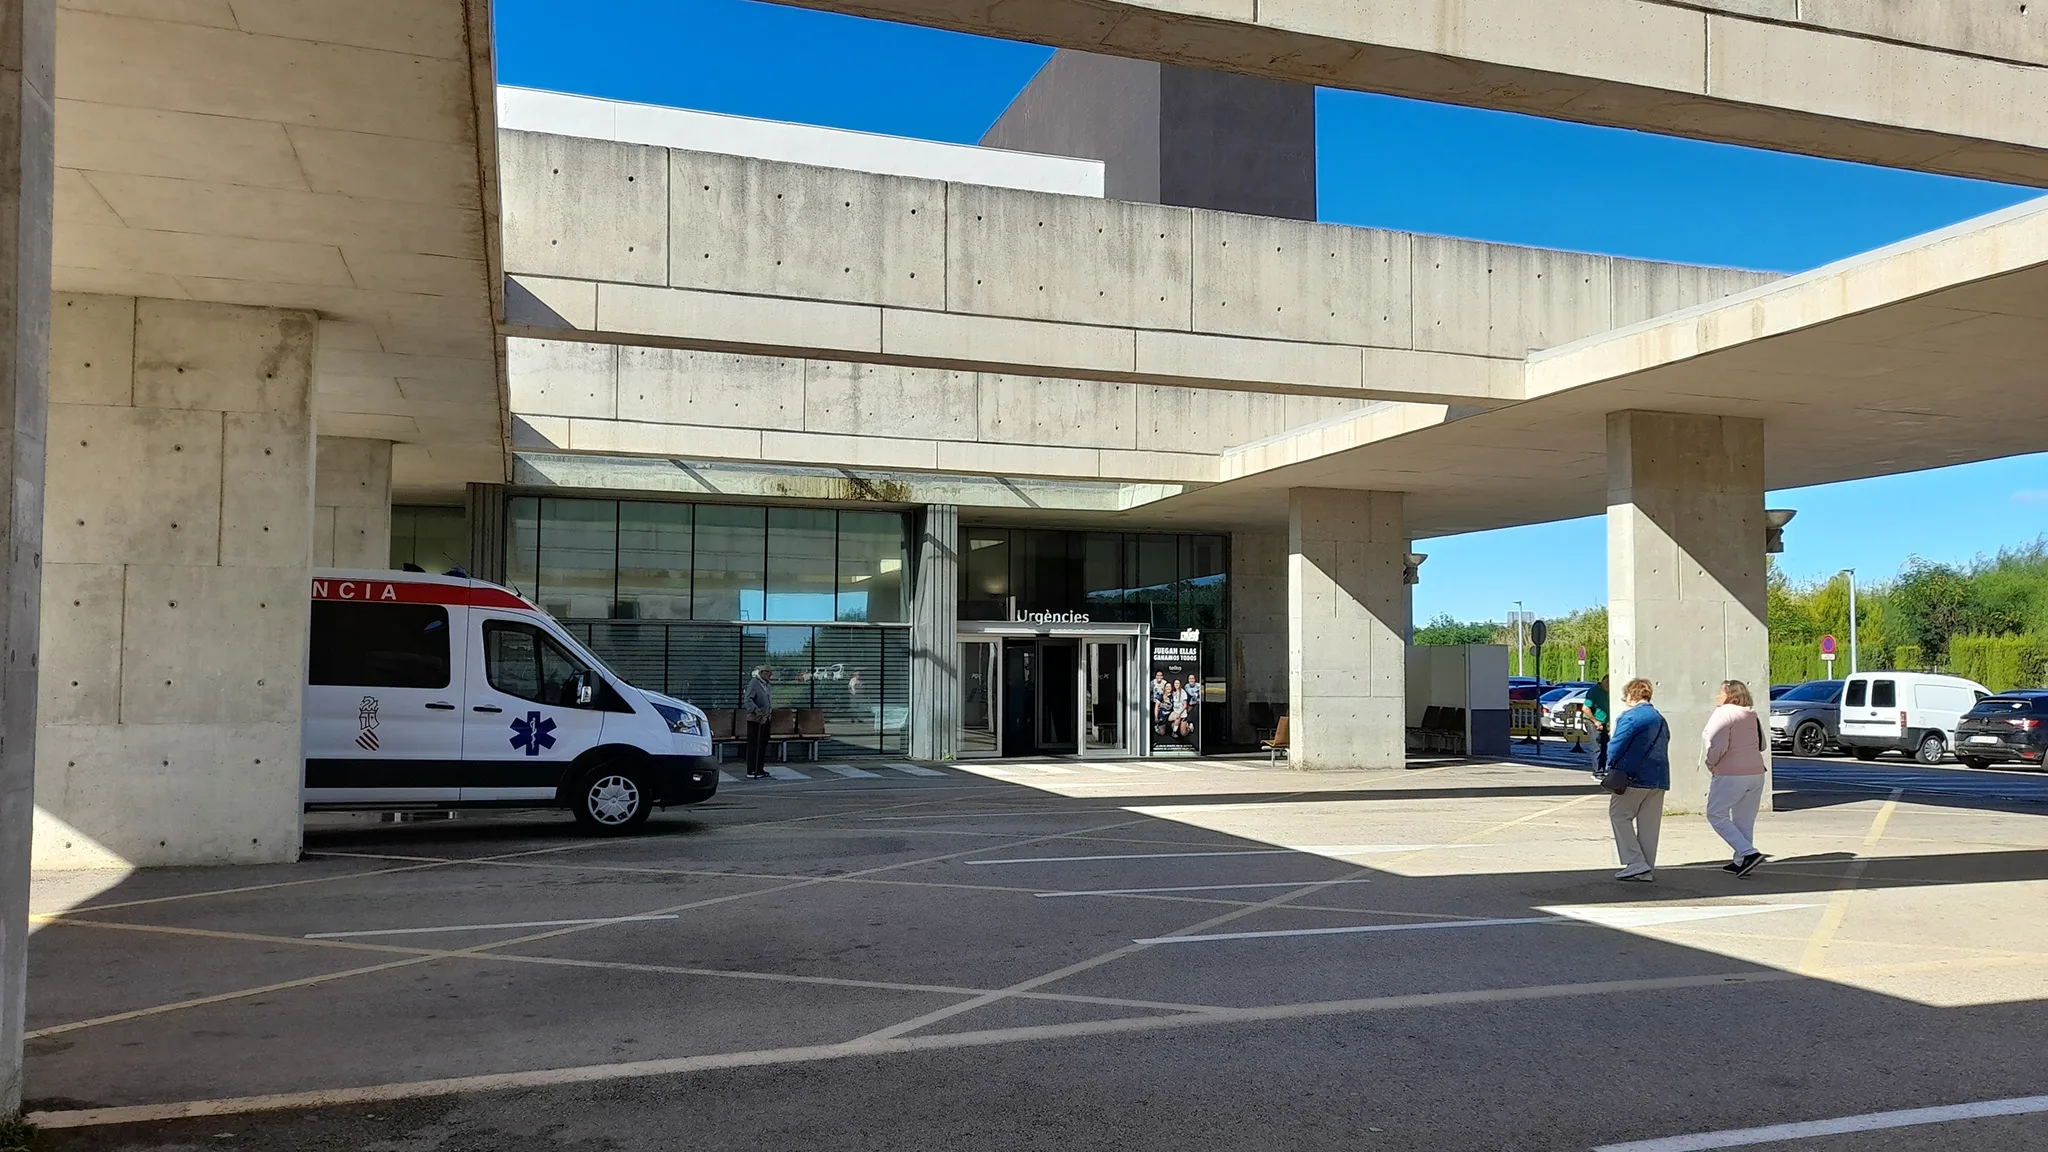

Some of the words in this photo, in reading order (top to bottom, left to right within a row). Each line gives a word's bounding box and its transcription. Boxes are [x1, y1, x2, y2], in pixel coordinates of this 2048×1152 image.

[1016, 608, 1090, 626] Urgències
[1153, 647, 1178, 655] JUEGAN
[1179, 647, 1197, 655] ELLAS
